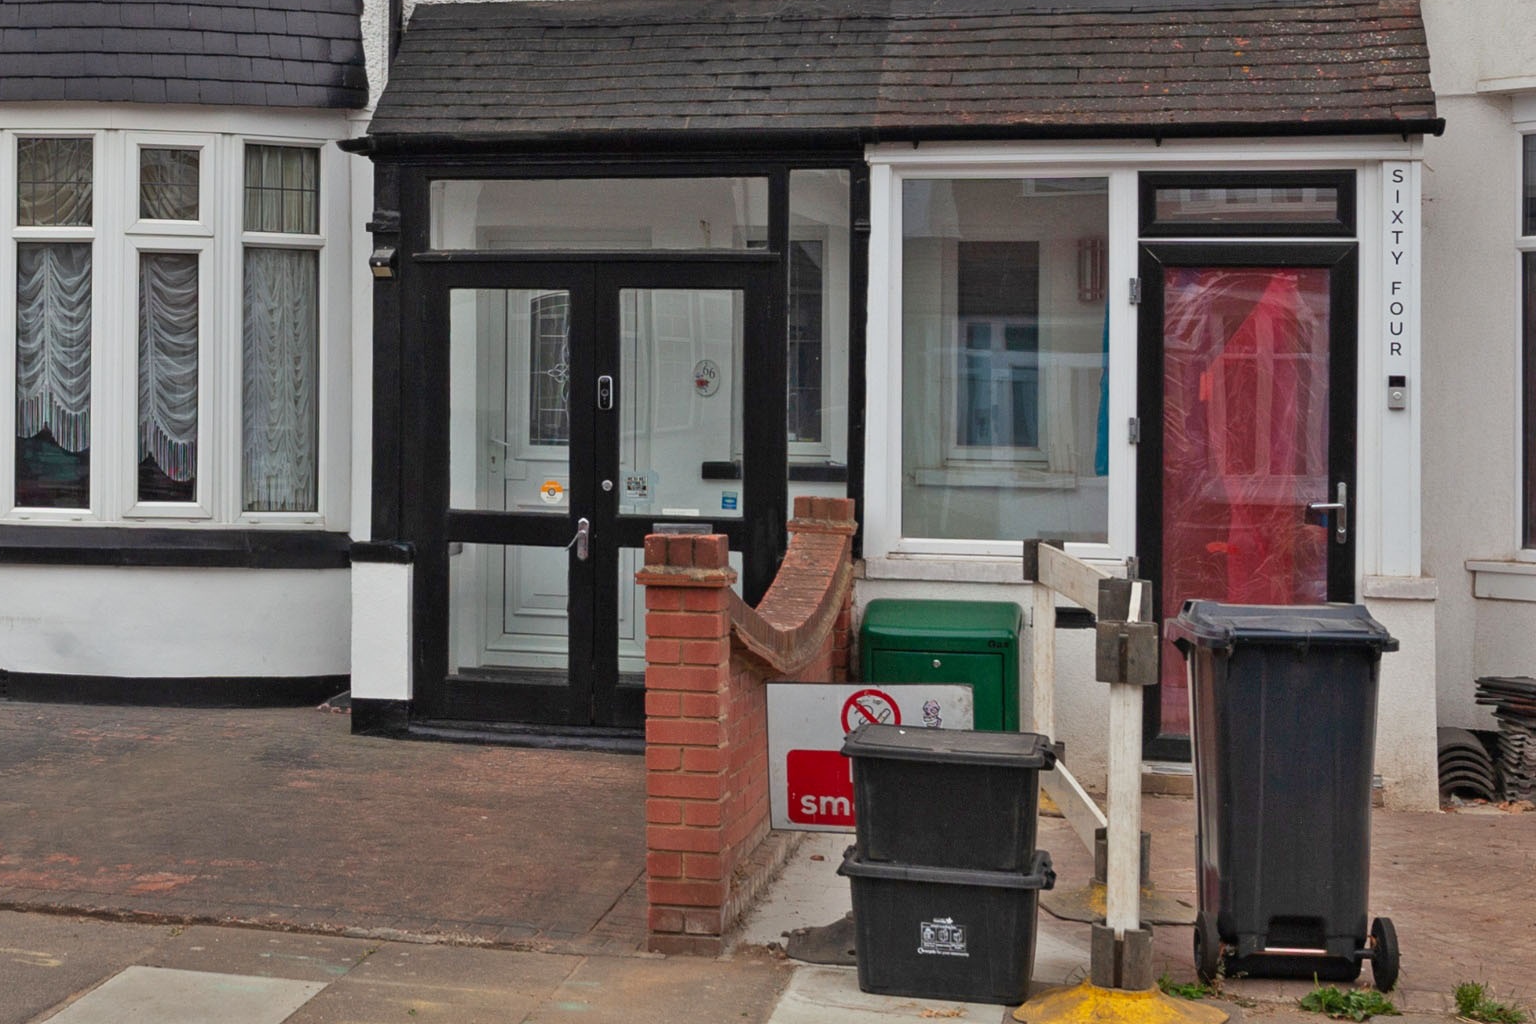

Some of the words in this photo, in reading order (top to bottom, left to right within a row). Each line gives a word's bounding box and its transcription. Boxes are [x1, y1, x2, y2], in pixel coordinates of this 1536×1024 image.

[1391, 168, 1404, 266] SIXTY
[1389, 281, 1404, 356] FOUR
[703, 366, 716, 379] 66
[800, 794, 855, 816] sm
